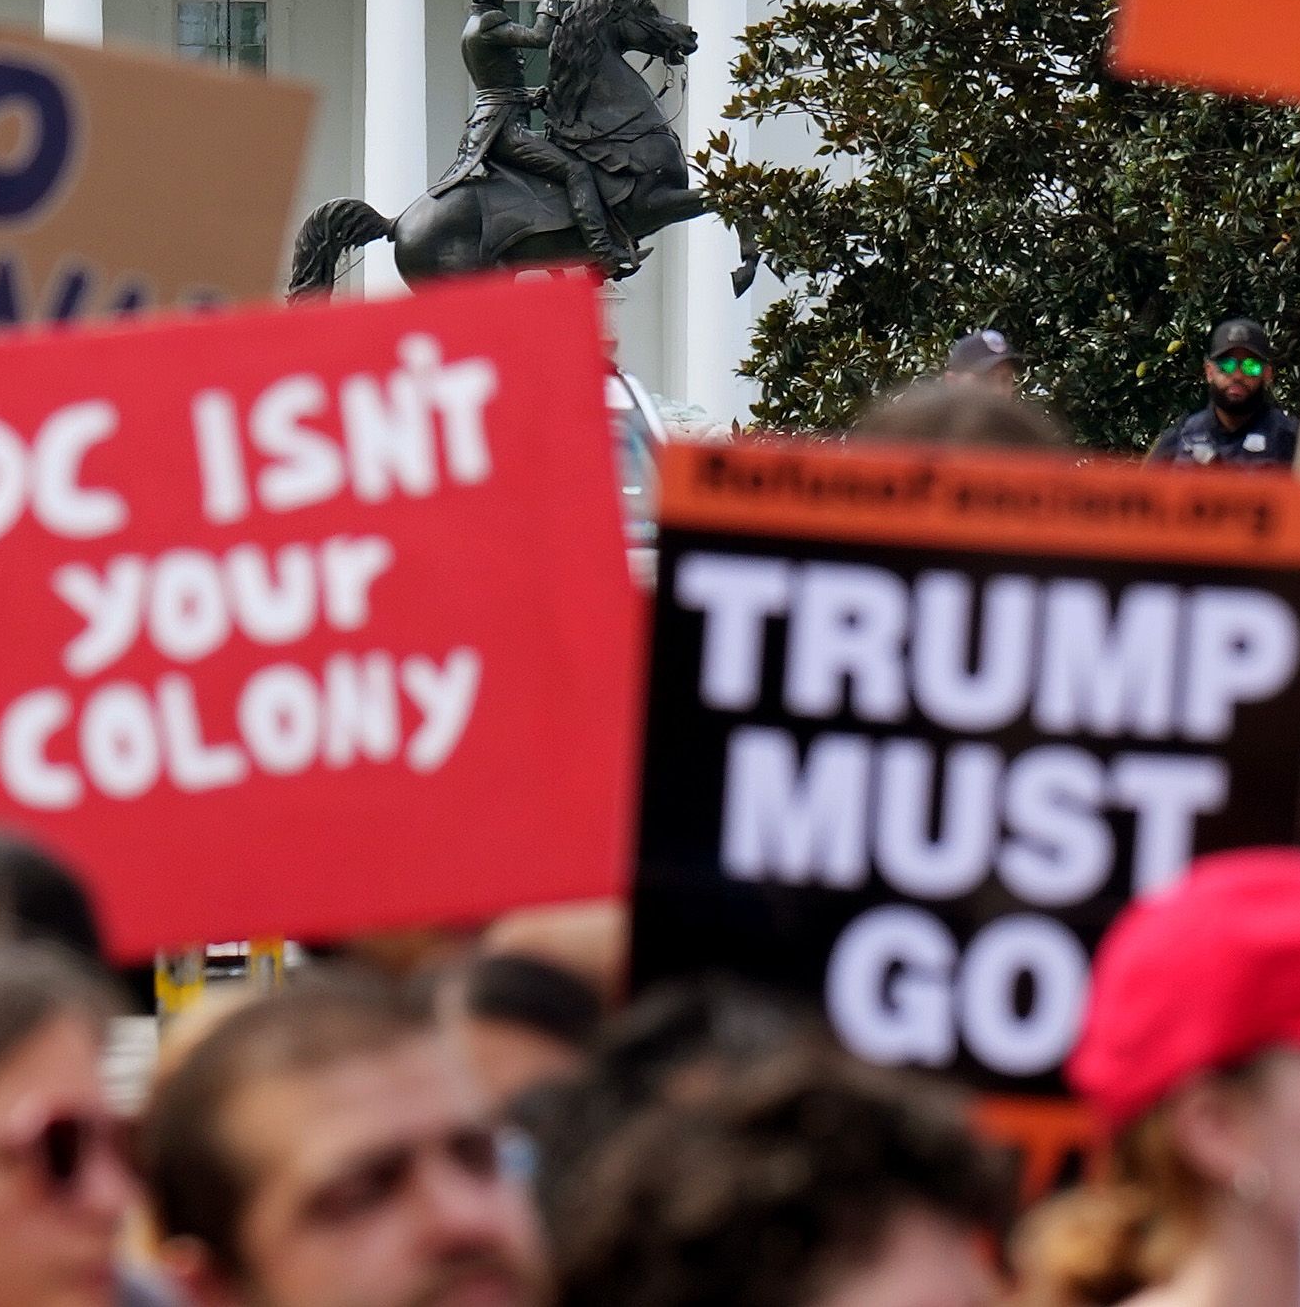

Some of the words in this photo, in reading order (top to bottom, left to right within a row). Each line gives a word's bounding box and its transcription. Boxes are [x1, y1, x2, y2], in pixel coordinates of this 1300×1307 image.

[191, 334, 498, 526] ISN'T
[674, 554, 1300, 741] TRUMP
[721, 727, 1231, 907] MUST
[827, 907, 1093, 1076] GO
